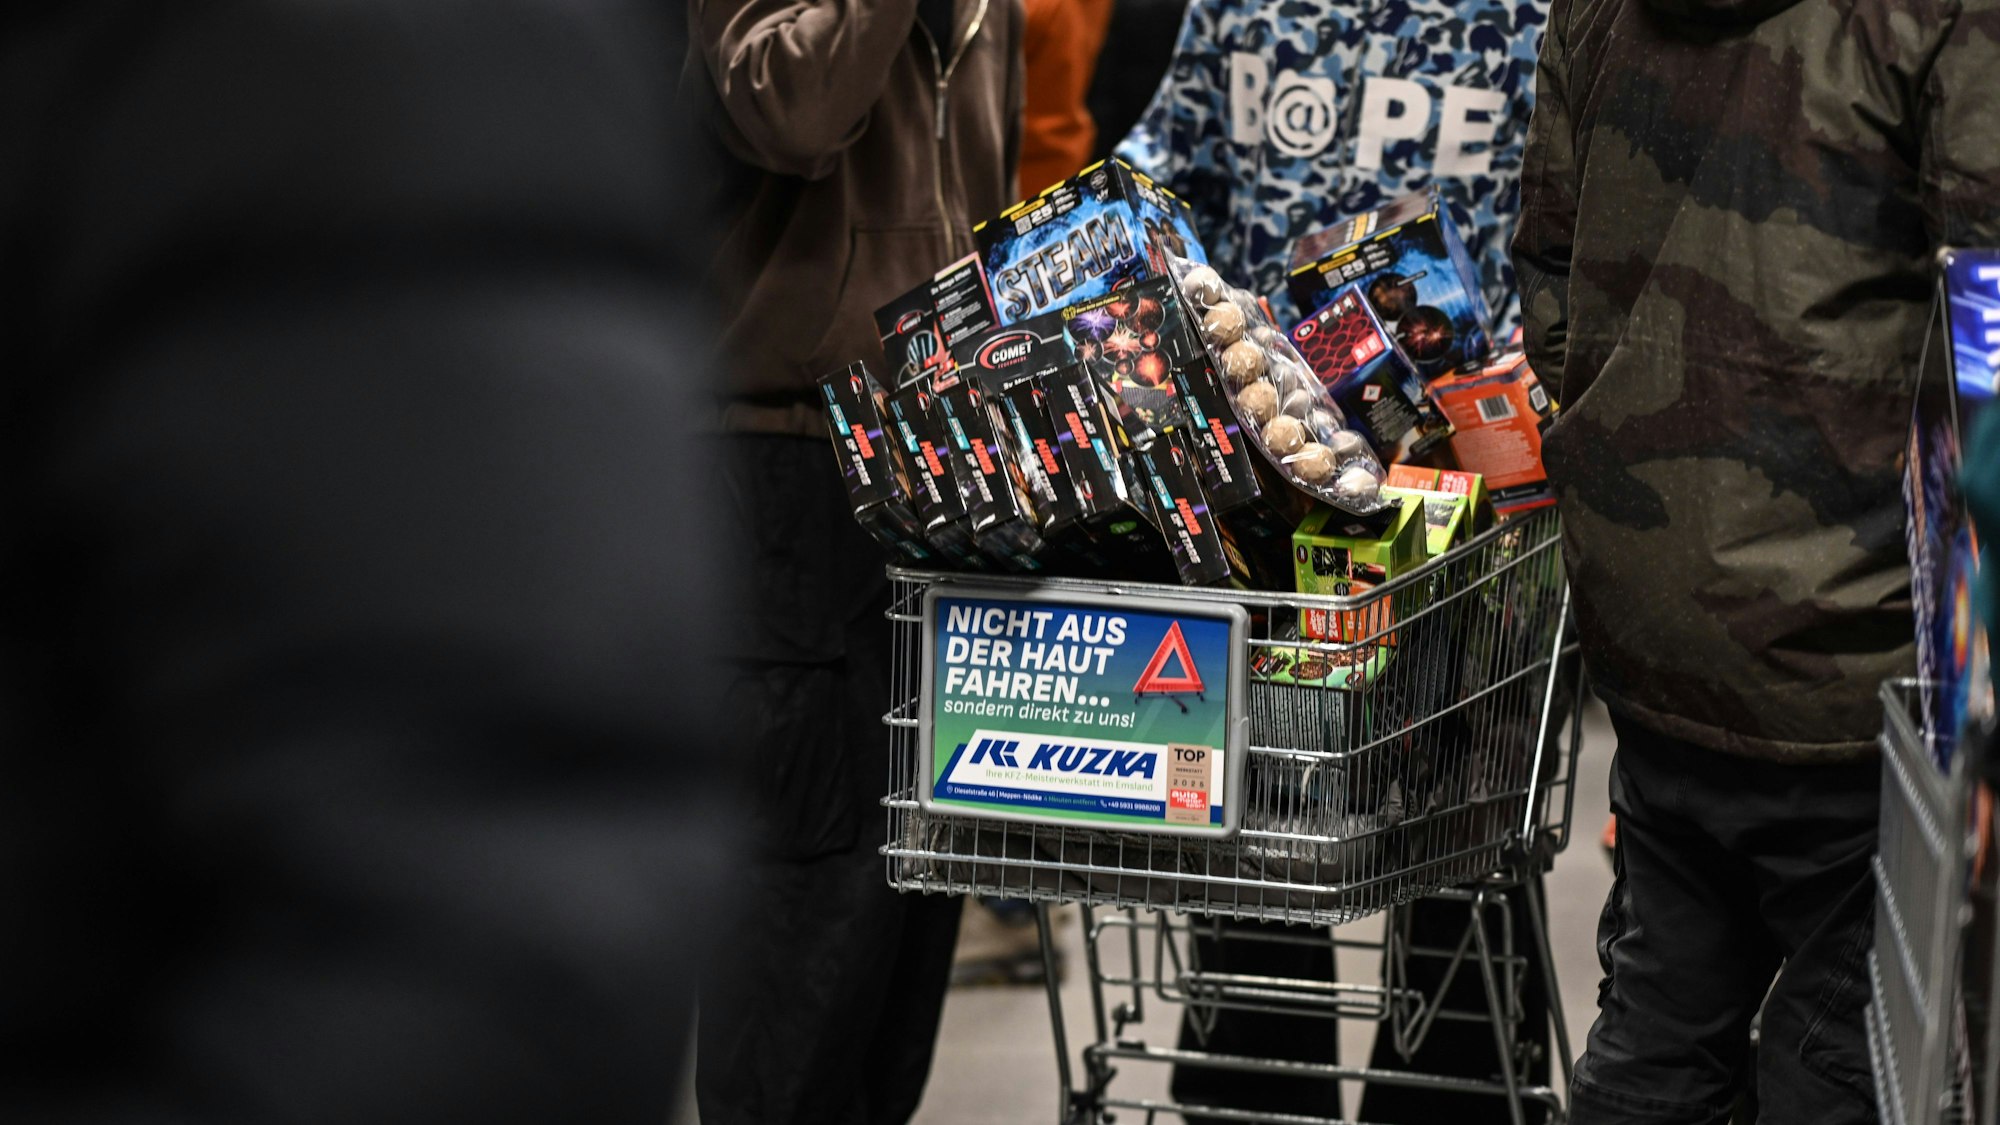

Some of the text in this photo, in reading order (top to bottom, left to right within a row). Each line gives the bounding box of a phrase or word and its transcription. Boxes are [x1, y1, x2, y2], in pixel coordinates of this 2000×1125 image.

[1030, 204, 1053, 224] 25
[996, 209, 1134, 320] STEAM
[1340, 259, 1365, 278] 25
[992, 341, 1033, 364] COMET
[1068, 384, 1097, 434] OF STARS
[851, 424, 875, 459] KING
[1065, 412, 1091, 448] KING
[1208, 418, 1234, 455] KING
[852, 454, 872, 486] STARS
[920, 440, 944, 476] KING
[970, 438, 996, 475] KING
[1203, 432, 1232, 484] OF STARS
[922, 471, 942, 504] STARS
[972, 469, 994, 502] STARS
[1174, 498, 1202, 536] KING
[1170, 512, 1201, 564] OF STARS
[946, 605, 1128, 646] NICHT AUS
[946, 636, 1114, 675] DER HAUT
[944, 666, 1110, 708] FAHREN...
[944, 699, 1135, 728] sondern direkt zu uns!
[1028, 743, 1157, 779] KUZKA
[1174, 748, 1205, 763] TOP
[954, 786, 988, 798] Dieselstraße
[1048, 796, 1068, 804] Minuten
[1069, 798, 1096, 806] entfernt
[1107, 801, 1120, 809] +49
[986, 770, 1154, 792] Ihre KFZ-Meisterwerkstatt im Emsland
[1171, 790, 1198, 799] auto
[1173, 779, 1204, 788] 2025
